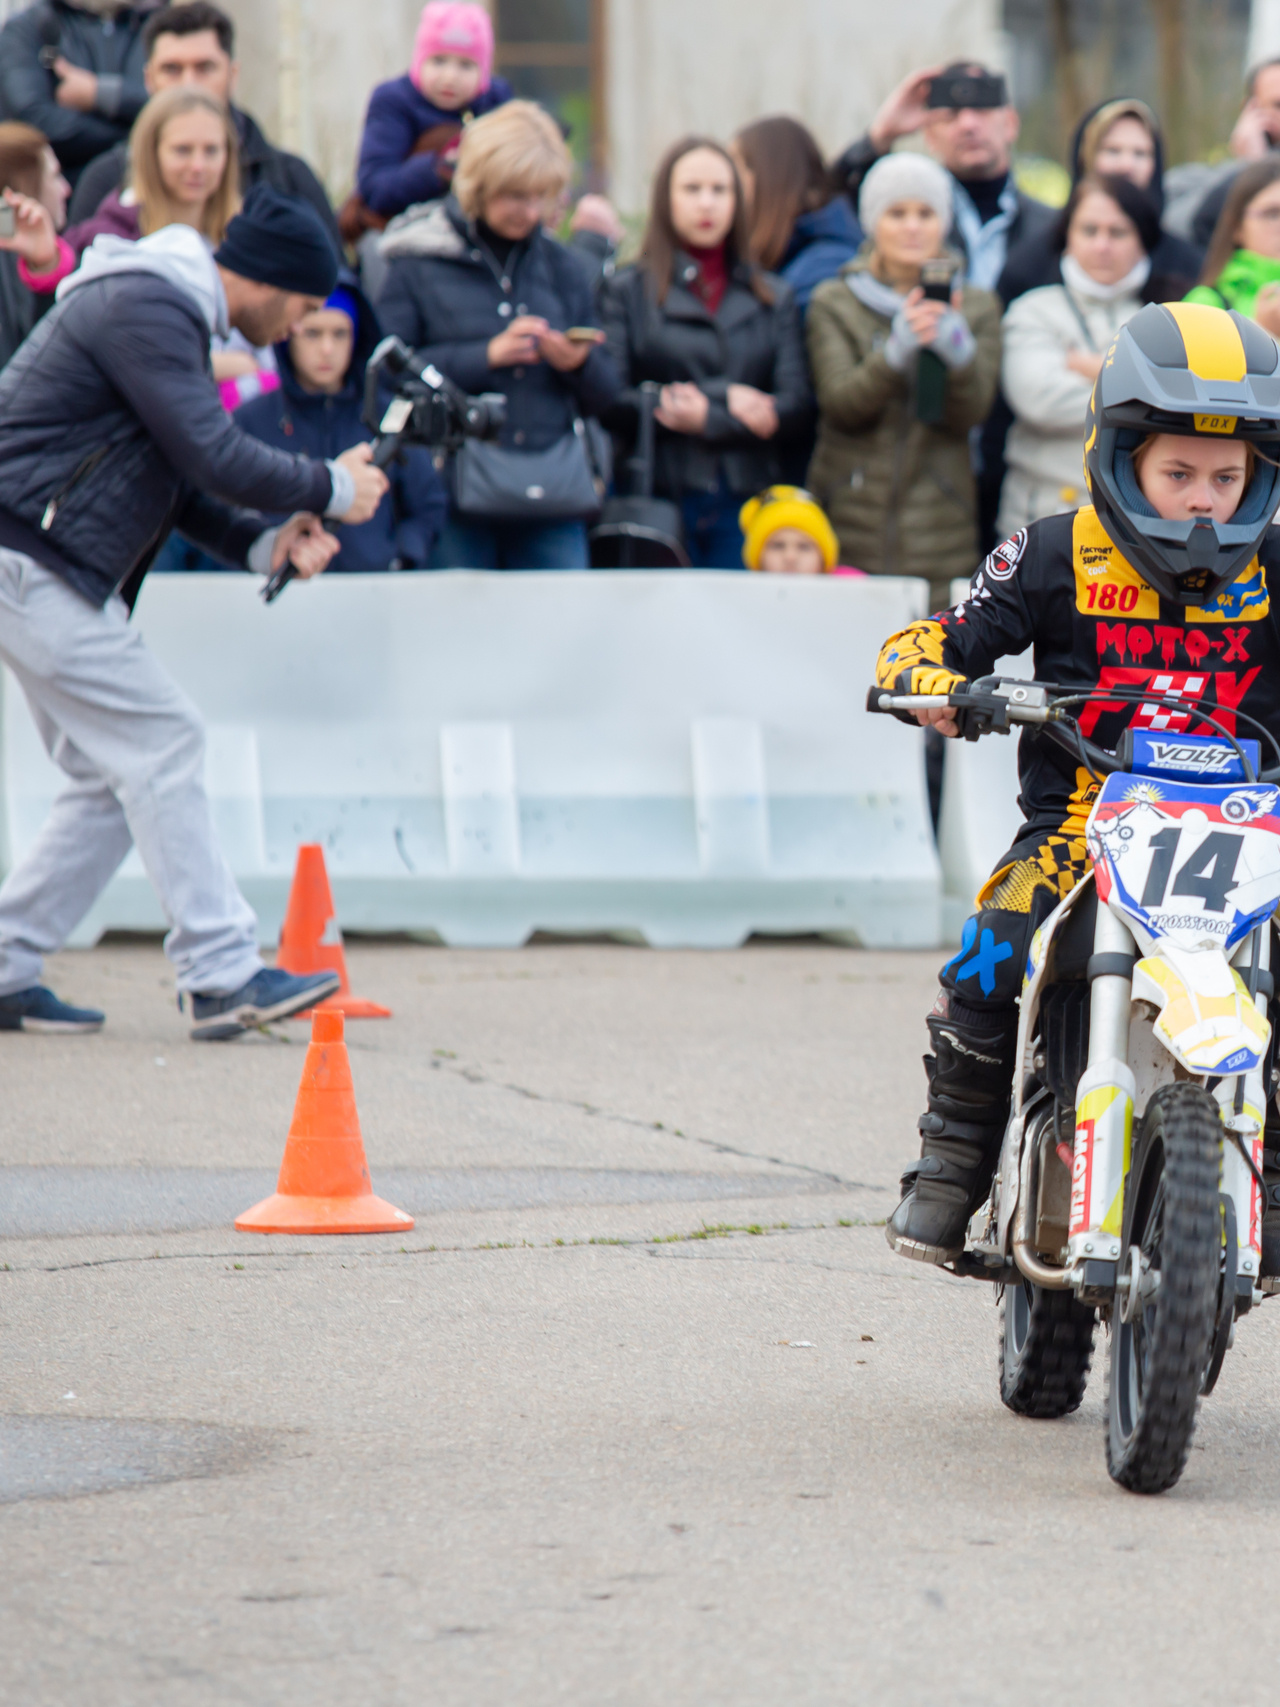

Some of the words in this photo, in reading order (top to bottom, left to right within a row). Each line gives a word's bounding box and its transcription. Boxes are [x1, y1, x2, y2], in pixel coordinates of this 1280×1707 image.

[1199, 417, 1231, 429] FOX
[1086, 582, 1139, 612] 180
[1095, 621, 1251, 672] MOTO-X
[1077, 665, 1263, 738] FOX
[1147, 741, 1240, 771] VOLT
[1138, 827, 1245, 914] 14
[1147, 914, 1237, 935] CROSSFORT
[1069, 1129, 1089, 1232] MOTUL
